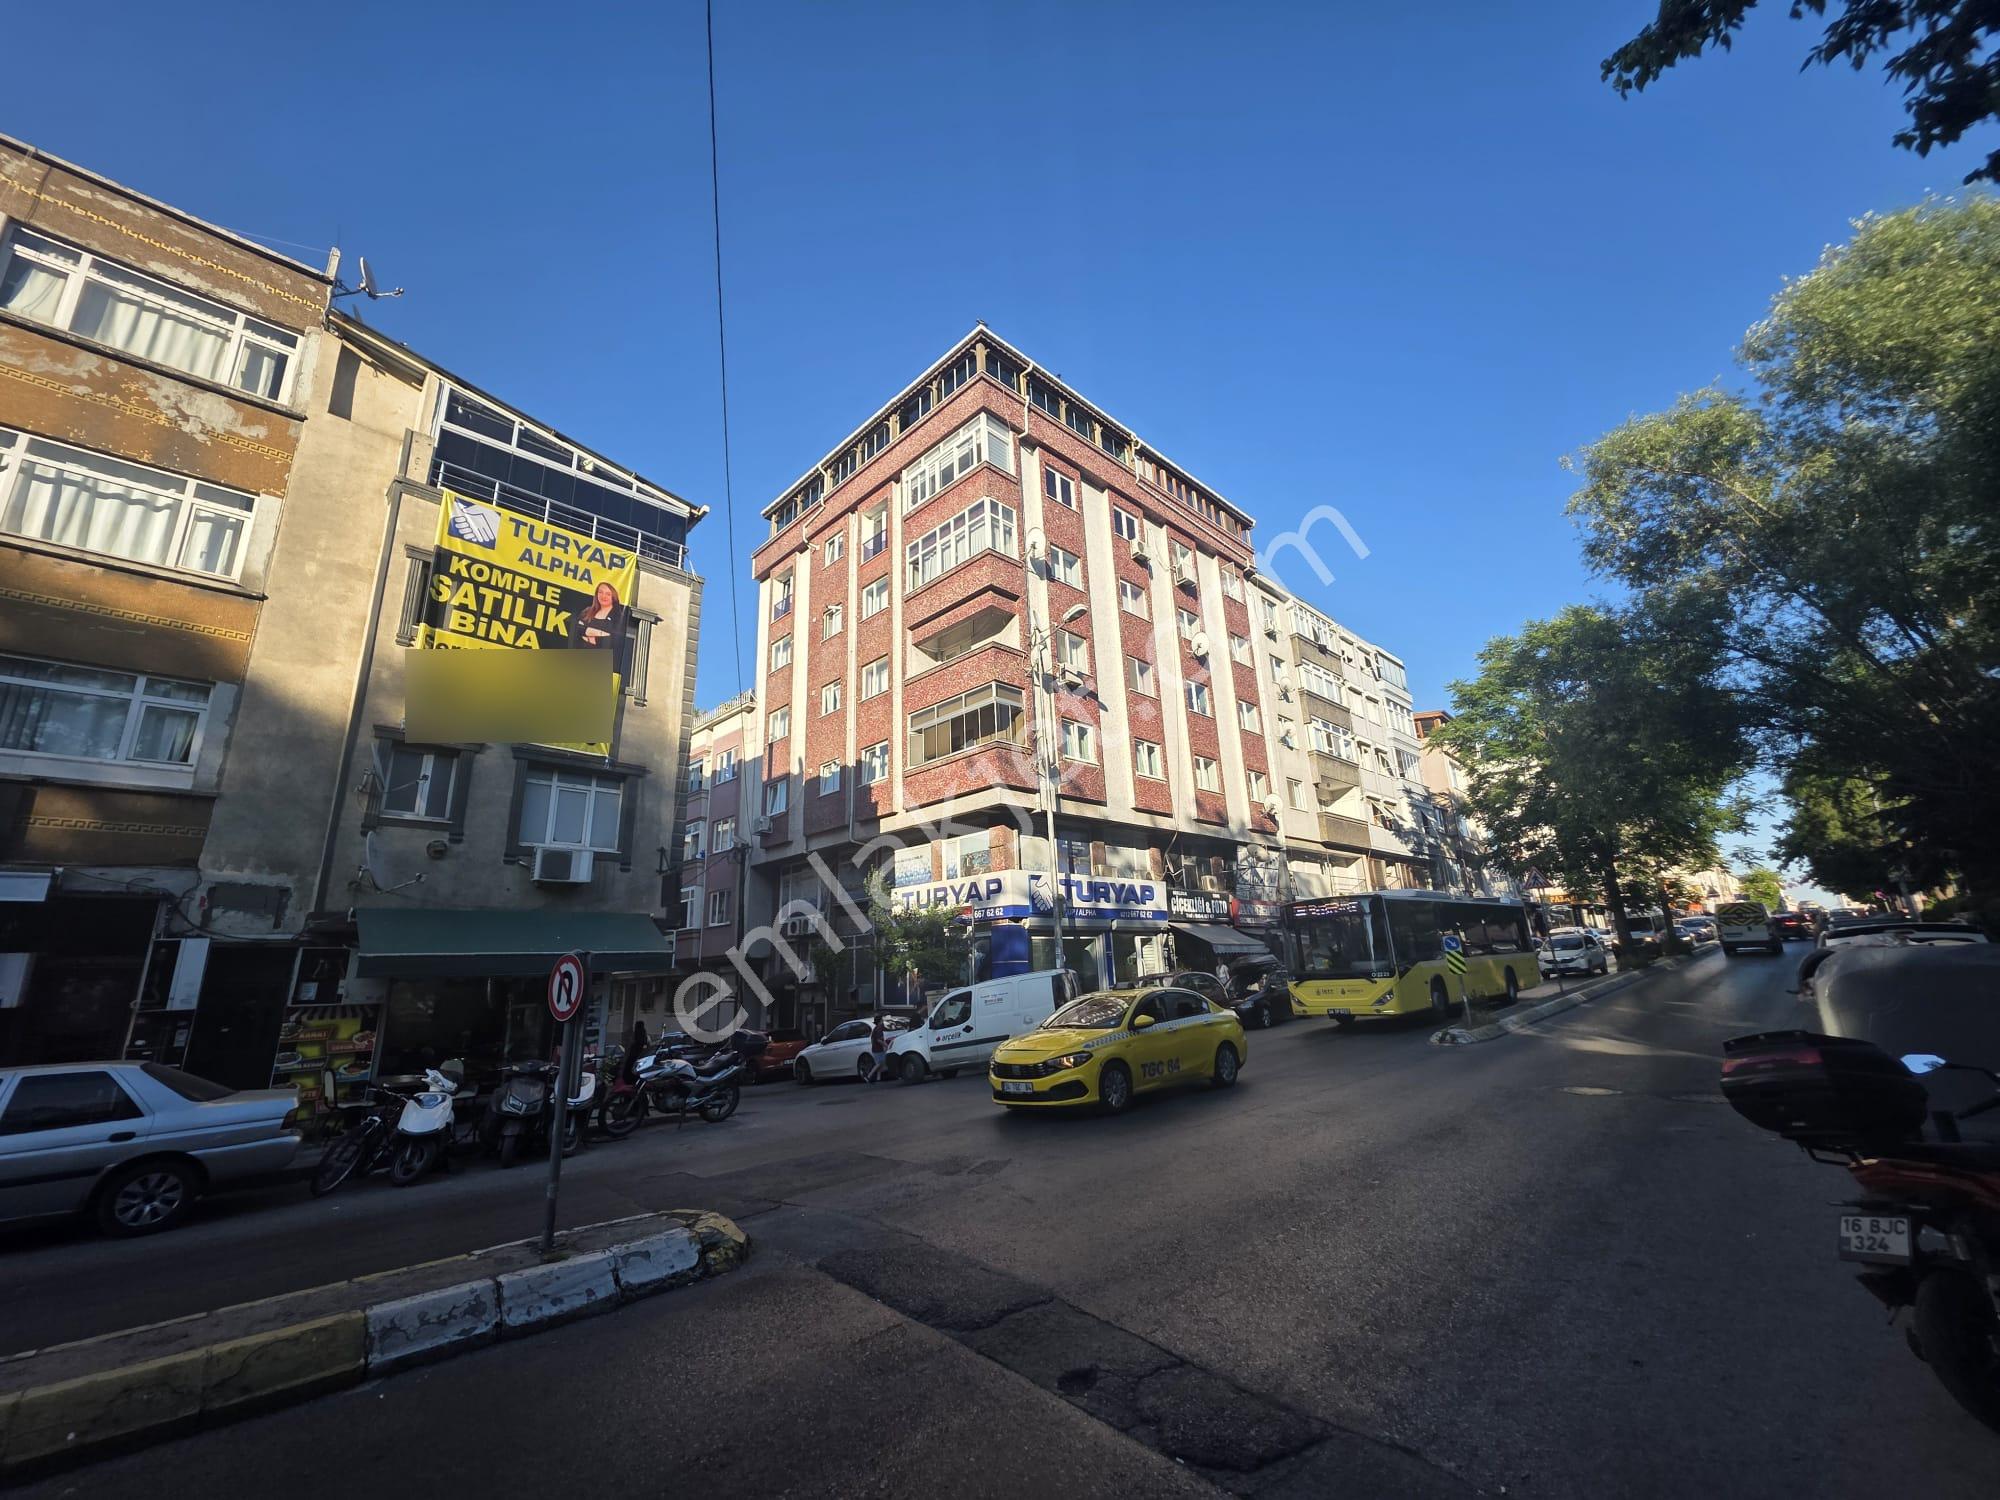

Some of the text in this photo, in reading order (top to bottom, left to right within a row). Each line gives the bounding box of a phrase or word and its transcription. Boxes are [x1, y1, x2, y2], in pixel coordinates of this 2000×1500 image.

[508, 516, 626, 571] TURYAP
[449, 555, 562, 606] KOMPLE
[518, 548, 594, 585] ALPHA
[429, 573, 572, 638] SATILIK
[901, 877, 1003, 911] TURYAP
[1059, 878, 1155, 906] TURYAP
[1211, 899, 1228, 914] FOTO
[986, 908, 995, 917] 62
[995, 907, 1004, 916] 62
[1843, 1218, 1906, 1235] 16 BJC
[1855, 1235, 1890, 1252] 324
